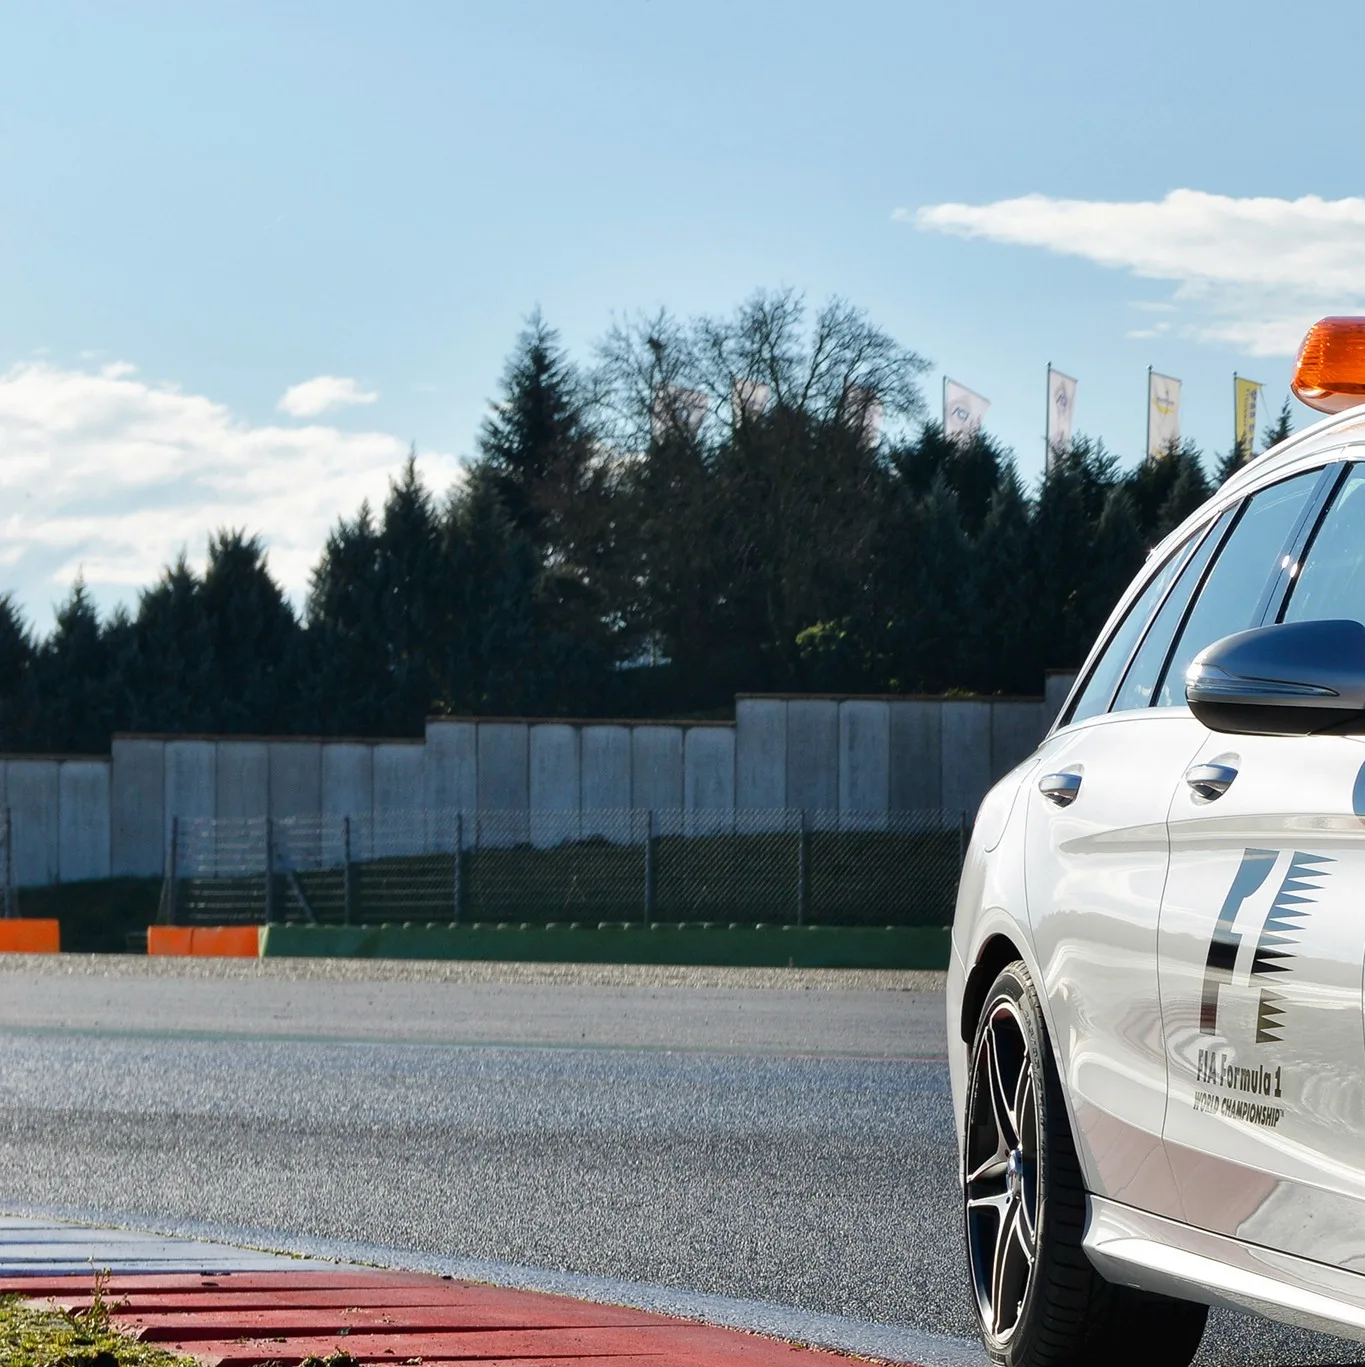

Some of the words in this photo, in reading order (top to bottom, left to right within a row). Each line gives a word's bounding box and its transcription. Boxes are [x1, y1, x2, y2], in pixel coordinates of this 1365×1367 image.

[1196, 1049, 1216, 1085] FIA
[1219, 1054, 1271, 1096] Formula
[1274, 1066, 1282, 1098] 1
[1193, 1091, 1220, 1114] WORLD
